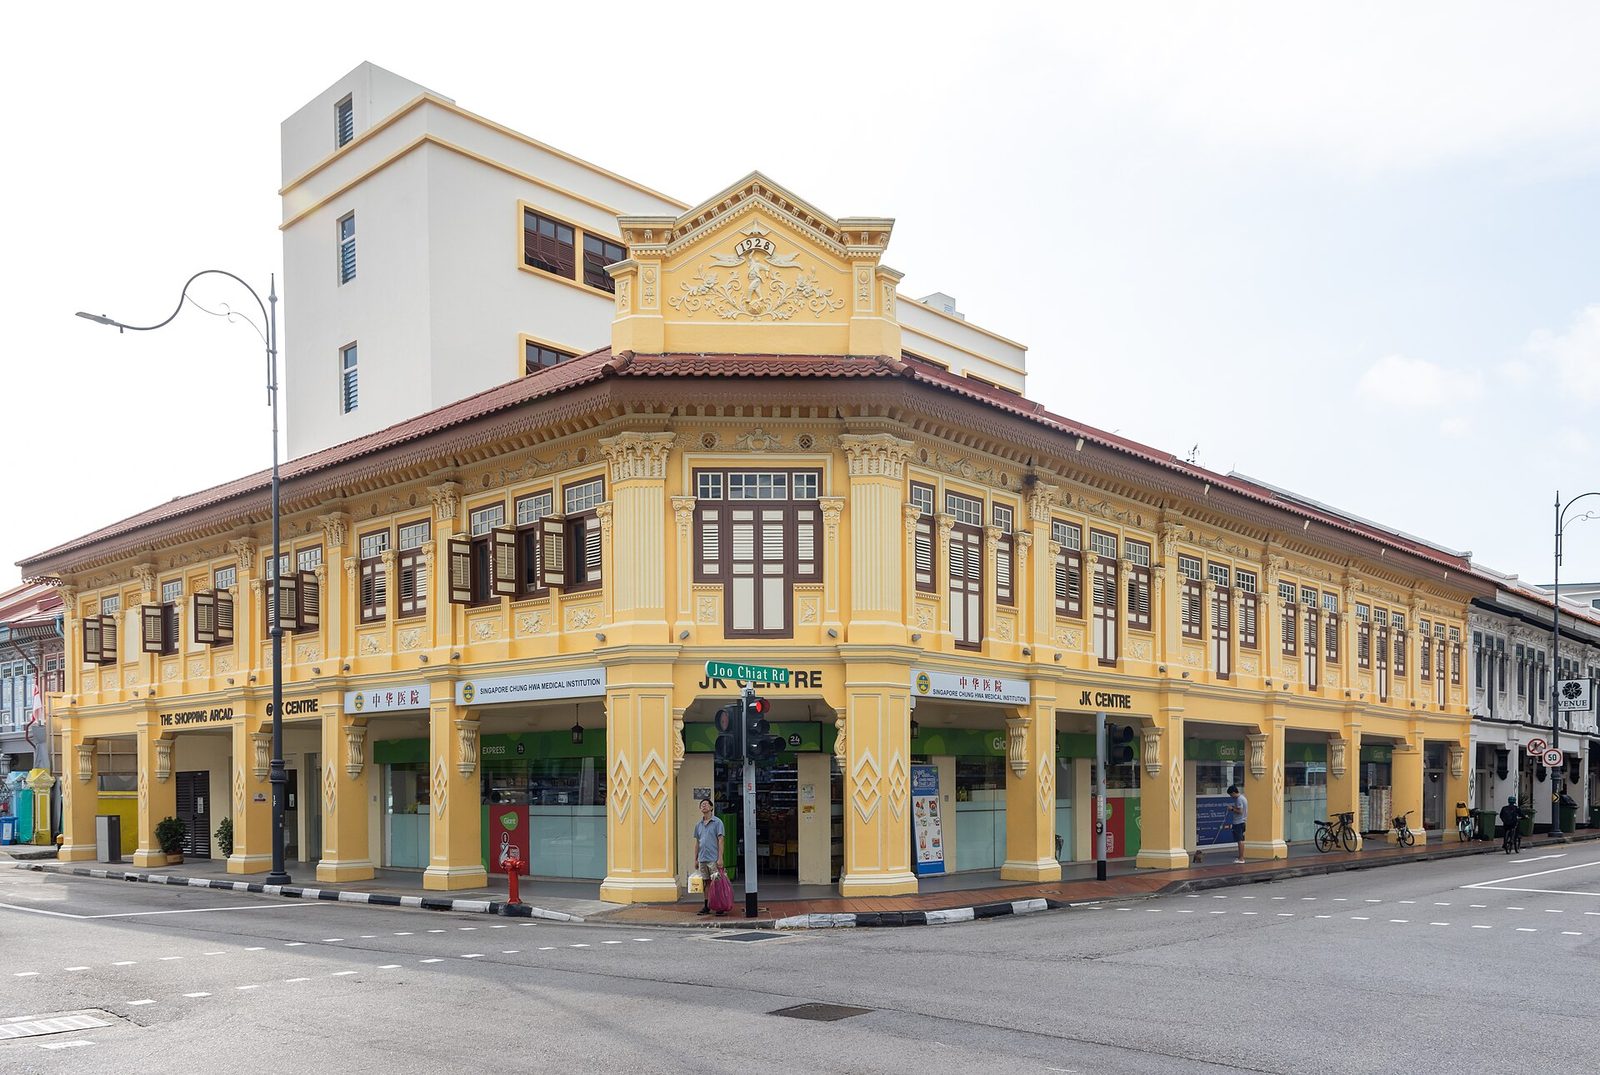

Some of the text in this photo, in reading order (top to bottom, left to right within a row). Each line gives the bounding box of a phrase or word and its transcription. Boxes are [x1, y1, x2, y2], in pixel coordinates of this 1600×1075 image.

[740, 238, 770, 251] 1928
[713, 663, 785, 681] Joo Chiat Rd
[480, 678, 601, 695] SINGAPORE CHUNG HWA MEDICAL INSTITUTION
[960, 676, 1002, 692] 中华医院
[372, 689, 419, 708] 中华医院
[932, 688, 958, 697] SINGAPORE
[984, 693, 1002, 701] MEDICAL
[1002, 695, 1027, 703] INSTITUTION
[1079, 691, 1131, 708] JK CENTRE
[285, 699, 319, 714] CENTRE
[160, 714, 173, 726] THE
[174, 710, 207, 725] SHOPPING
[482, 745, 506, 755] EXPRESS
[1548, 753, 1557, 761] 50
